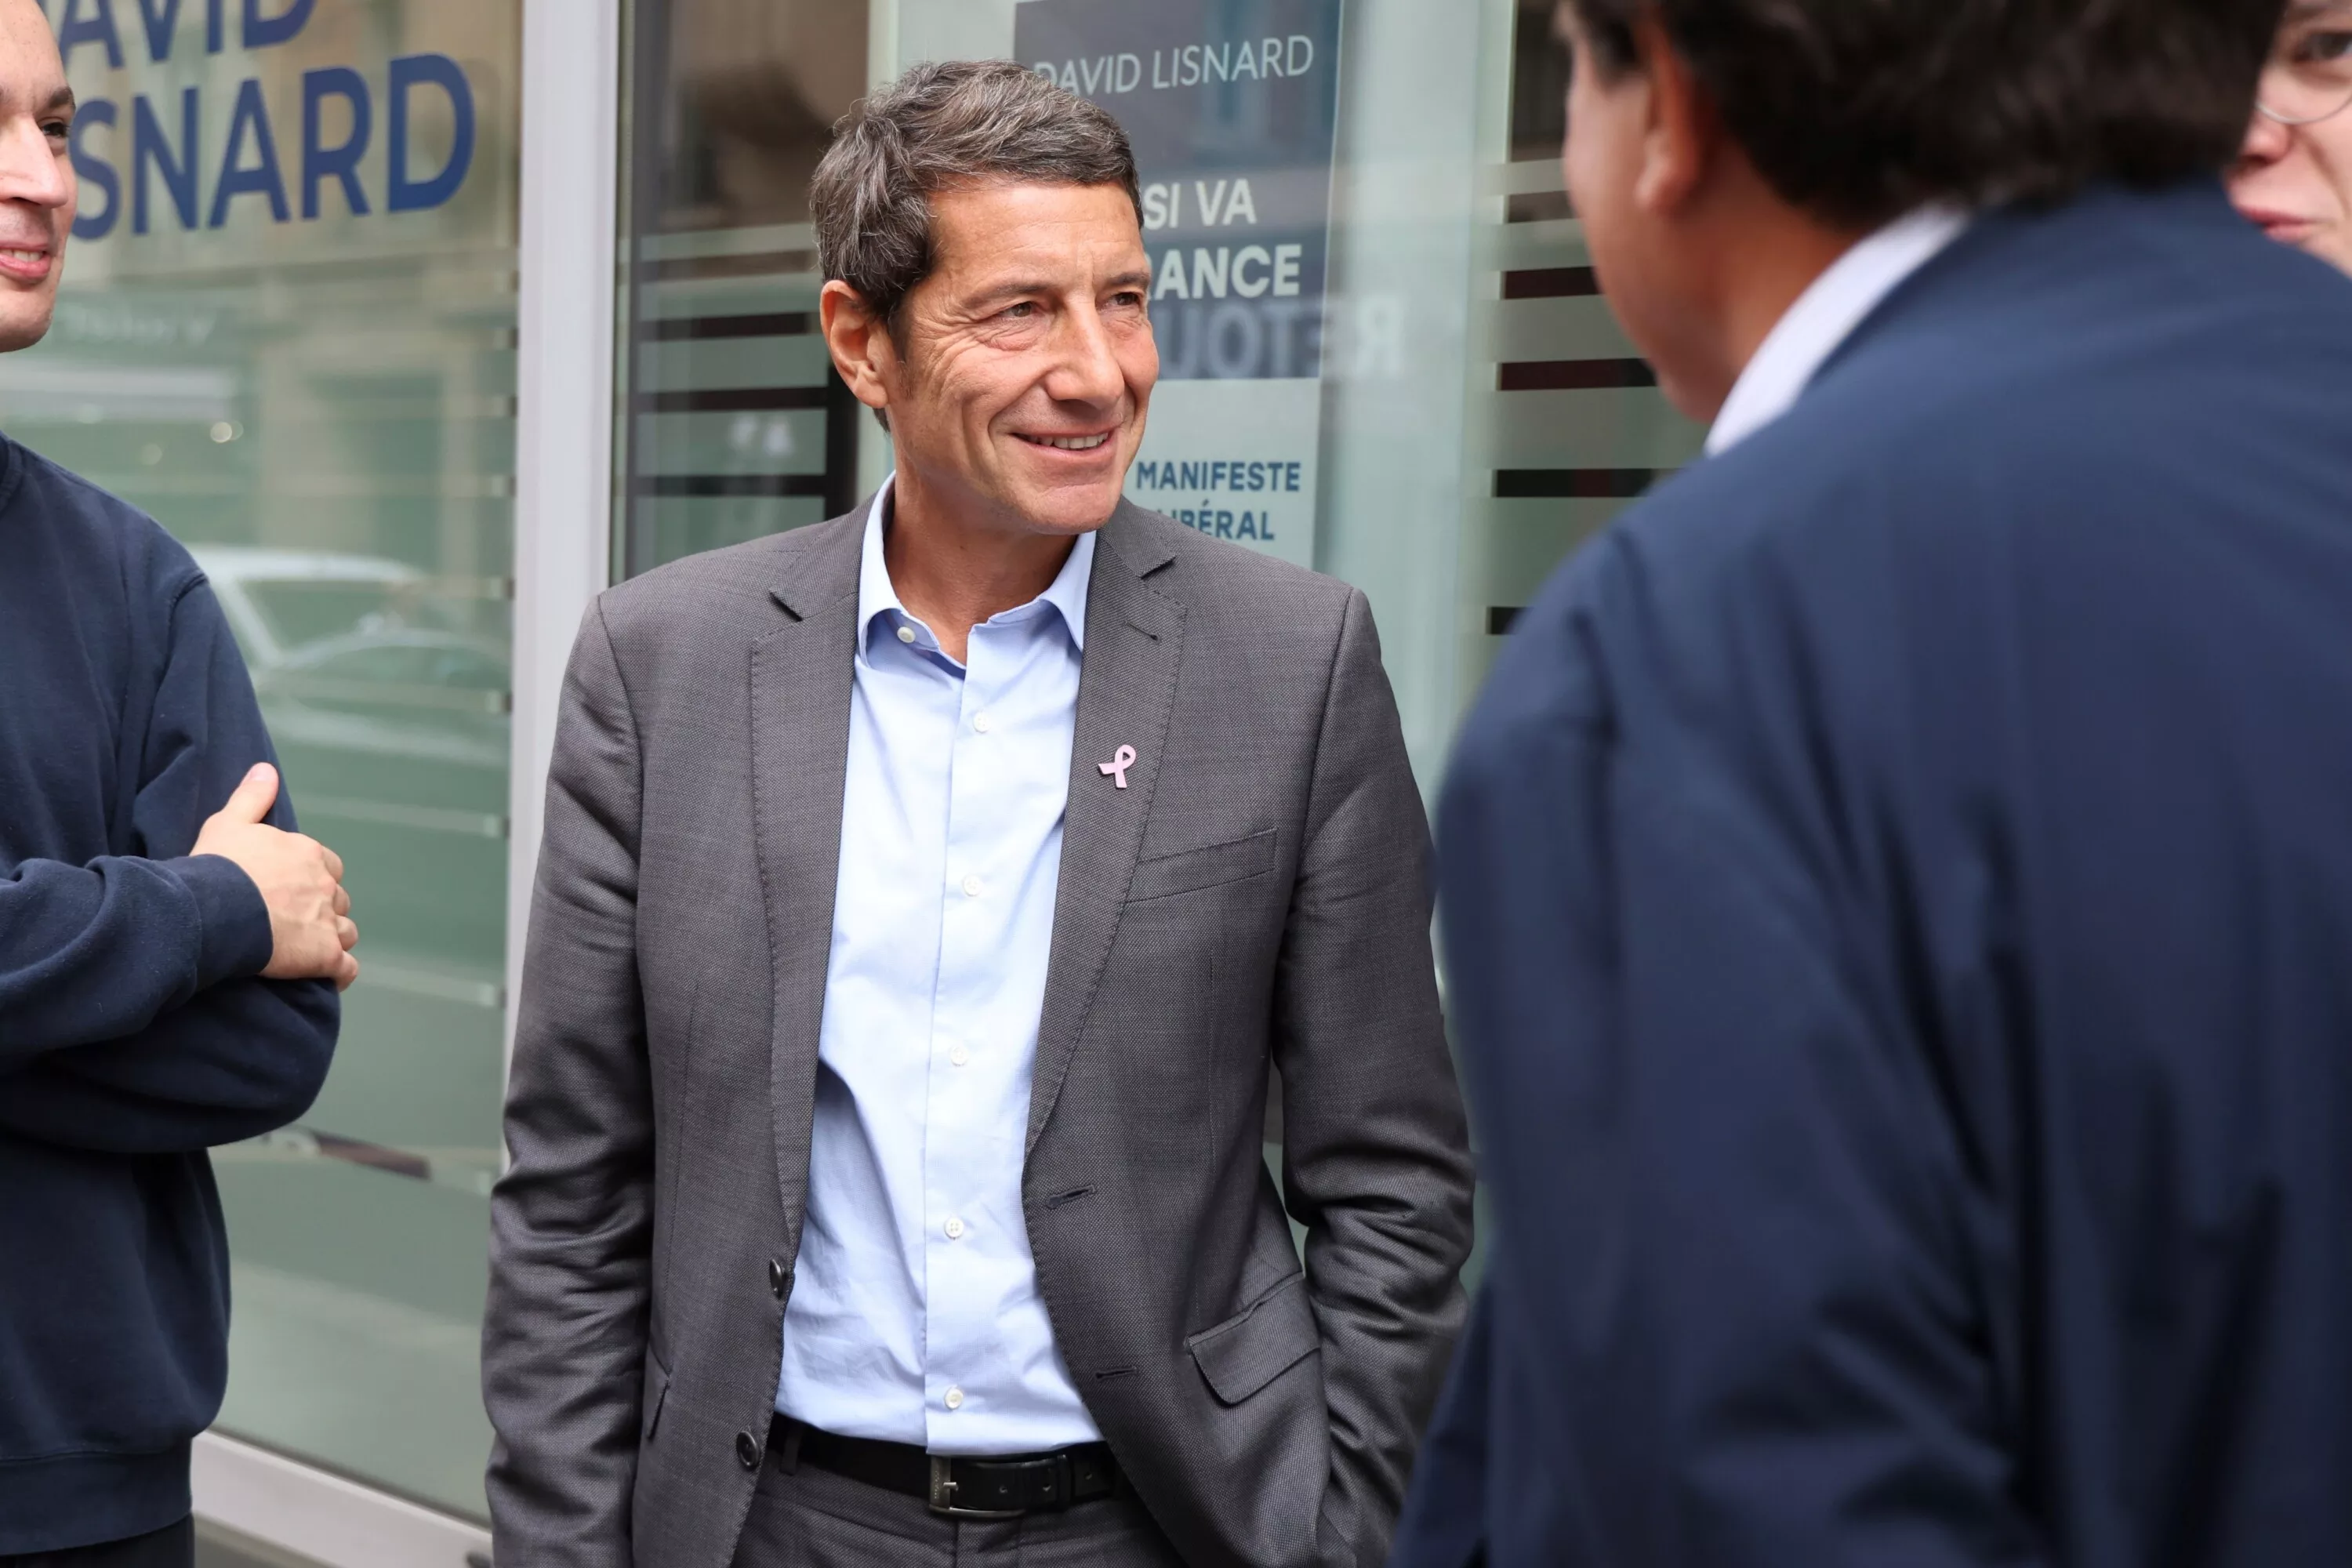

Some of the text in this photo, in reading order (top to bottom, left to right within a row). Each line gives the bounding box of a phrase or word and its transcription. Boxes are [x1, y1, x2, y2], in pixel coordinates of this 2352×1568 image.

[1152, 35, 1314, 89] LISNARD
[1195, 178, 1257, 227] VA
[1145, 244, 1302, 300] ANCE
[1136, 461, 1301, 492] MANIFESTE
[1157, 499, 1276, 541] BÉRAL
